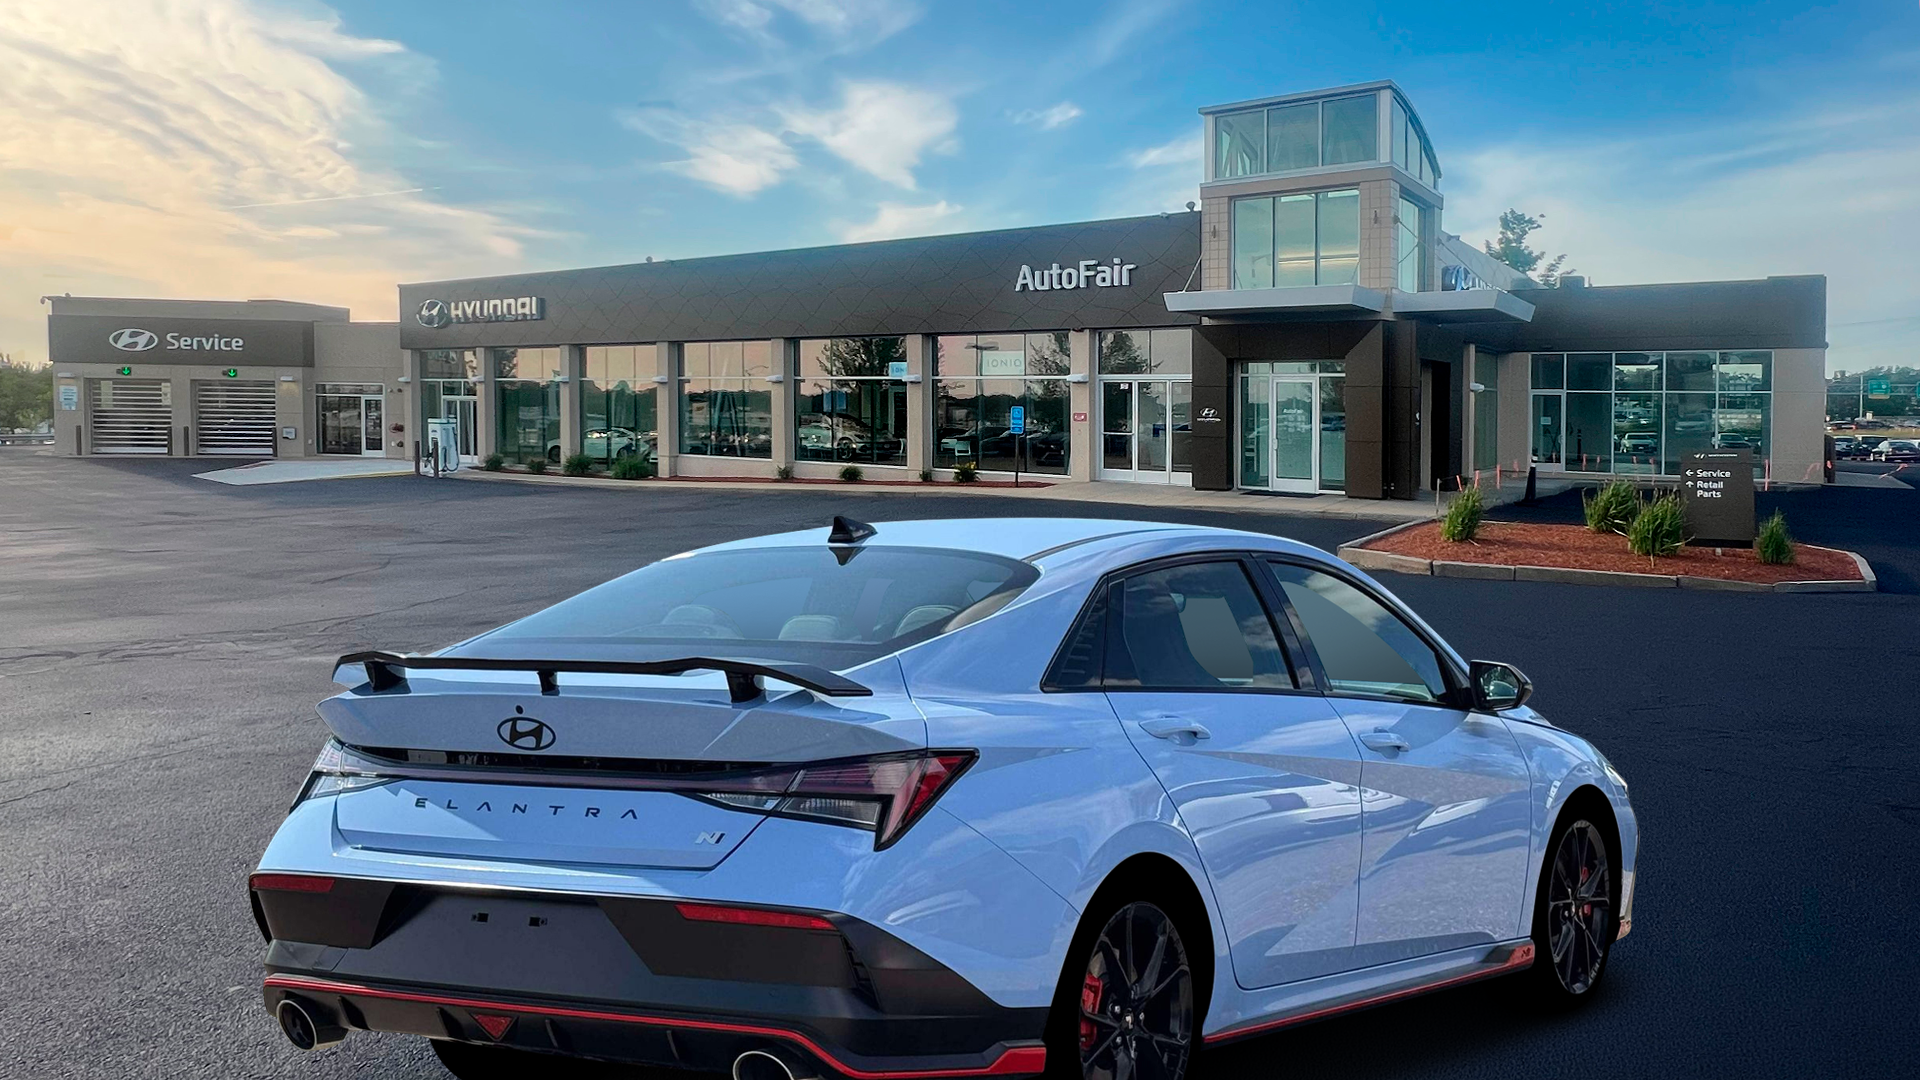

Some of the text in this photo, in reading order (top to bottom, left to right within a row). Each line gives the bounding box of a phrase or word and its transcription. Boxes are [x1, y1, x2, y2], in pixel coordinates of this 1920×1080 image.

[1015, 257, 1137, 291] AutoFair
[450, 296, 541, 323] HYUNDAI
[166, 332, 244, 351] Service
[1696, 469, 1731, 478] Service
[1696, 481, 1724, 489] Retail
[1697, 490, 1722, 498] Parts
[414, 797, 638, 820] ELANTRA
